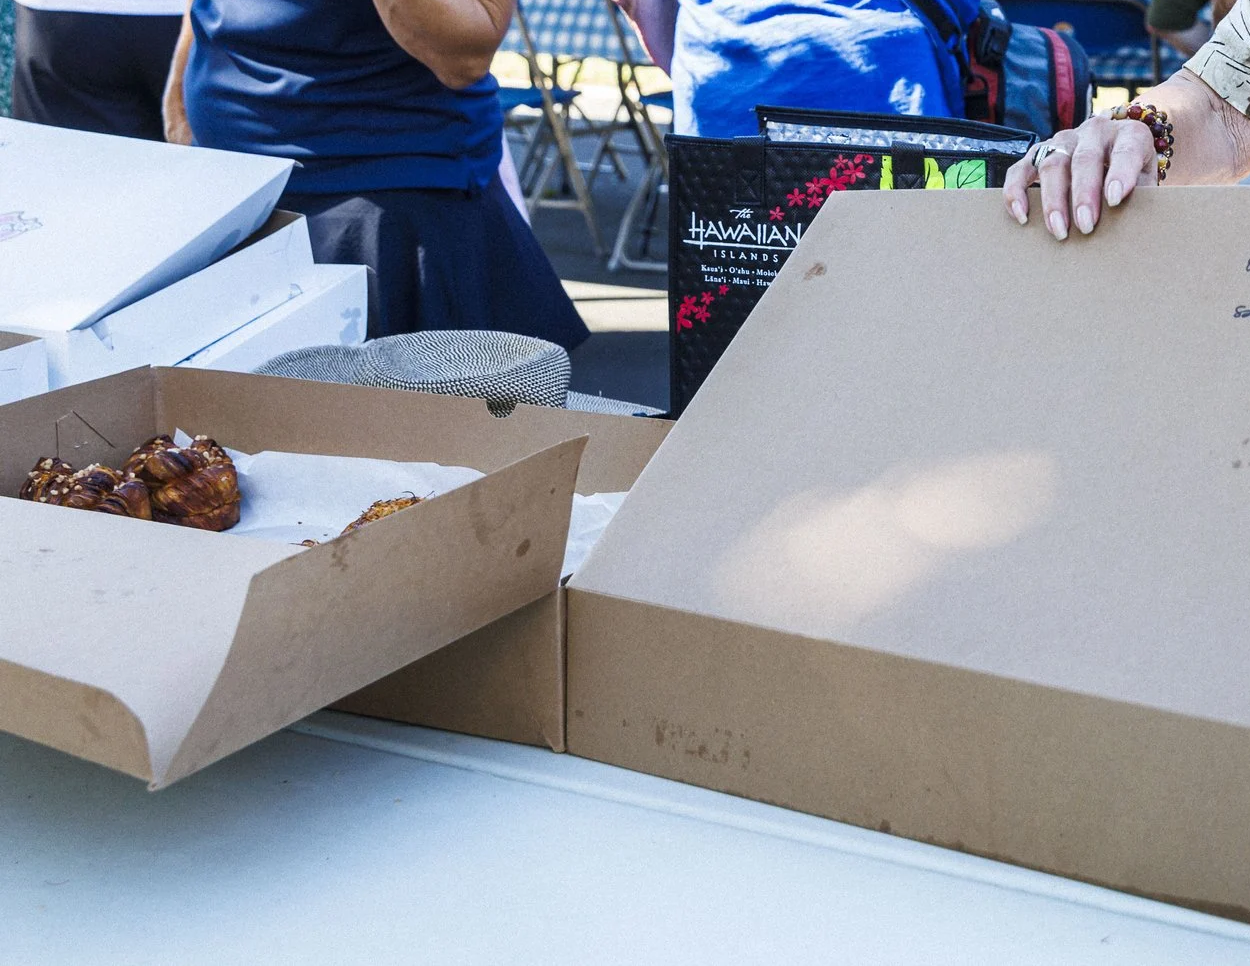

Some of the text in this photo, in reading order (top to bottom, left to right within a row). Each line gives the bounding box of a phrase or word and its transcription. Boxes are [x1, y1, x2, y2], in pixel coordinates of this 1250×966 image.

[729, 208, 754, 219] The
[688, 211, 801, 250] HAWAIIAN
[713, 250, 778, 262] ISLANDS
